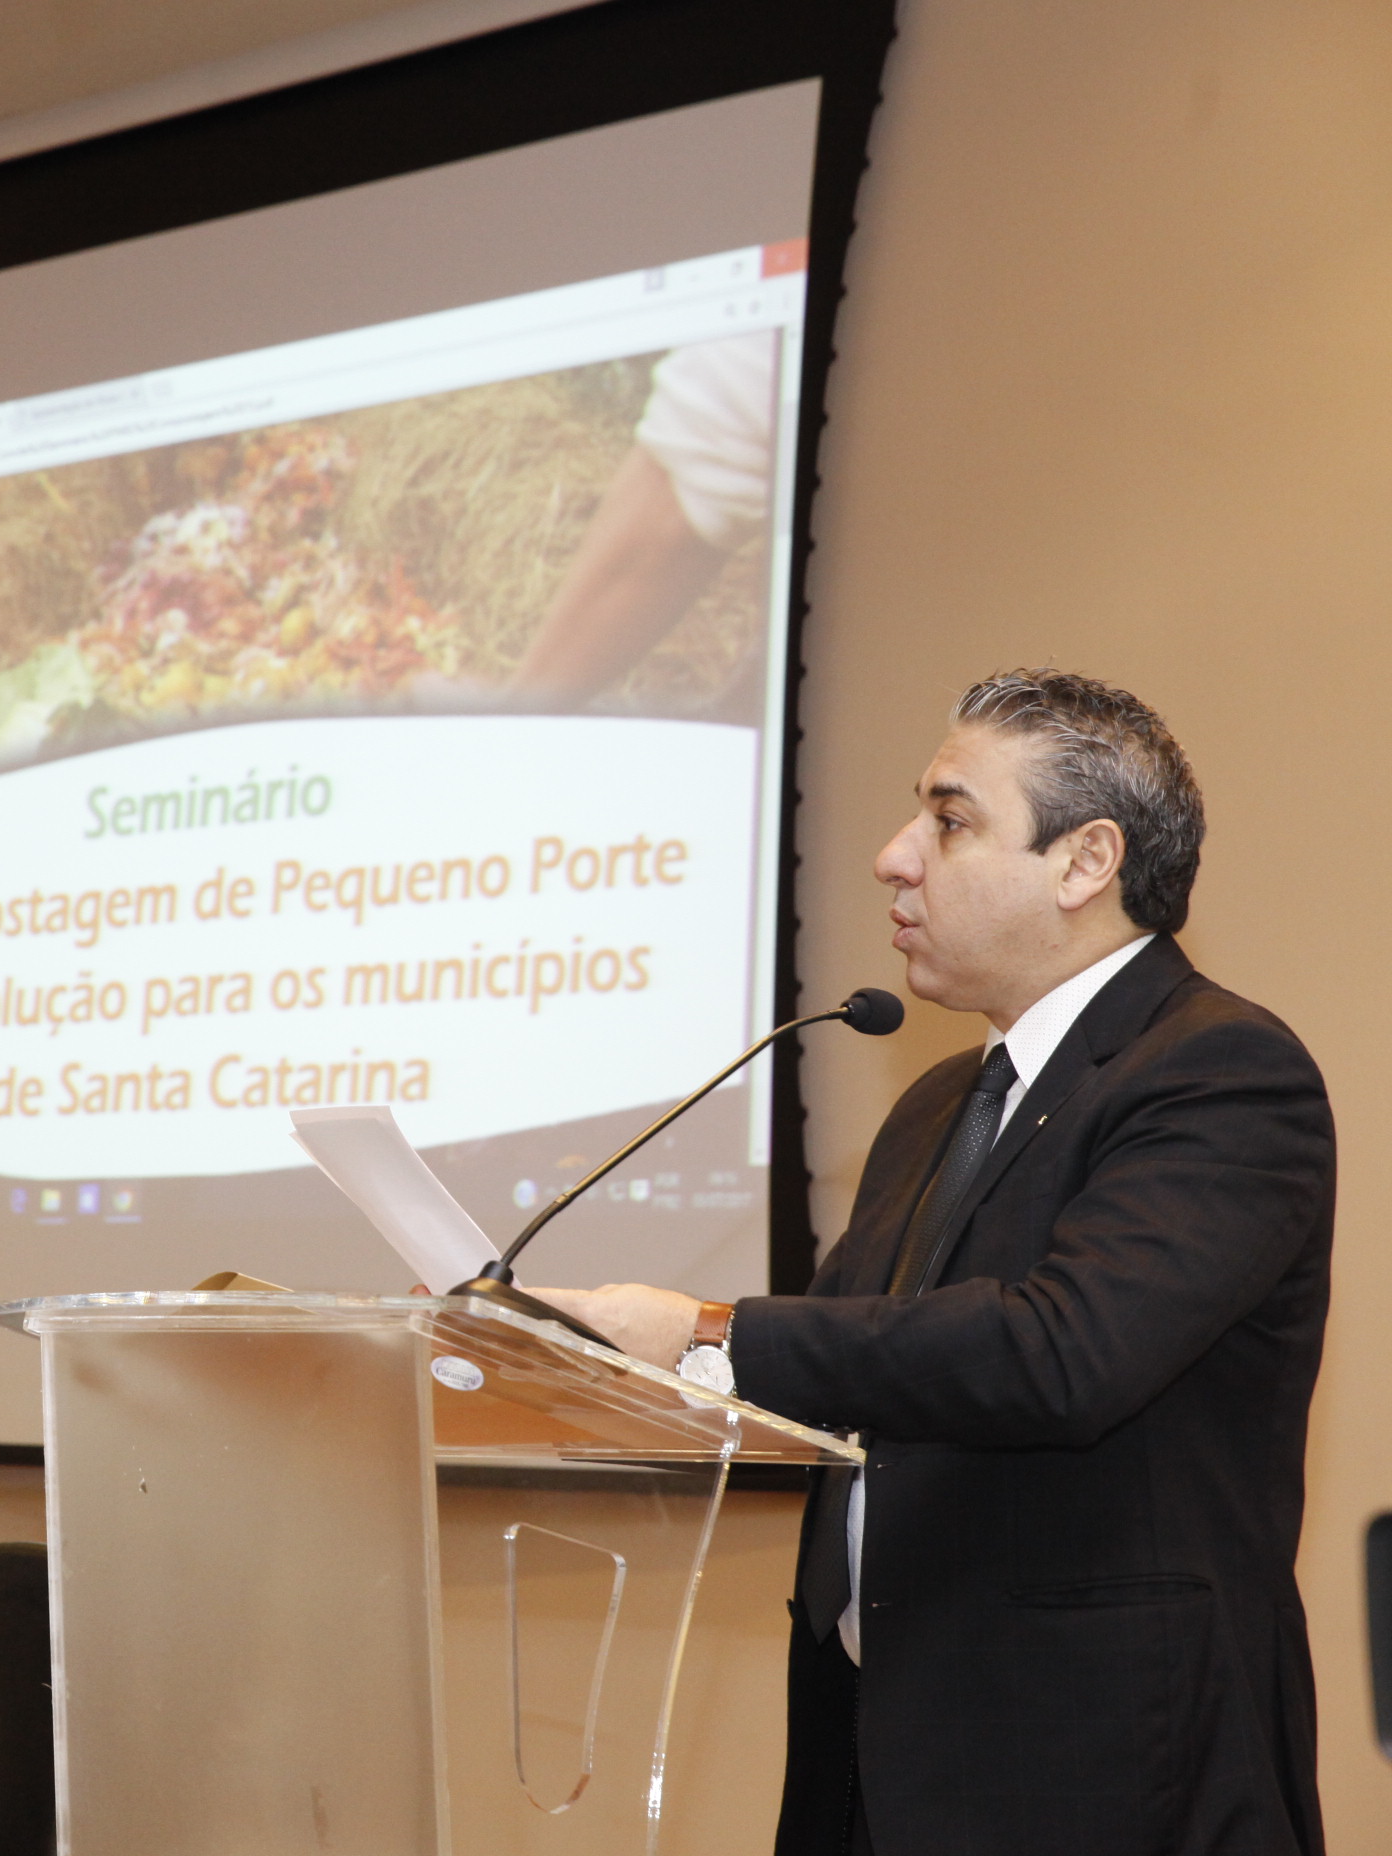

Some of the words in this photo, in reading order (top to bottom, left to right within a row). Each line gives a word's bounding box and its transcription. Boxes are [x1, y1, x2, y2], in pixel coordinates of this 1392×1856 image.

[82, 764, 333, 841] Seminário
[192, 866, 257, 922] de
[271, 853, 512, 926] Pequeno
[529, 833, 689, 895] Porte
[141, 970, 255, 1034] para
[269, 964, 328, 1011] os
[342, 936, 652, 1015] municípios
[56, 1060, 194, 1116] Santa
[207, 1049, 432, 1111] Catarina
